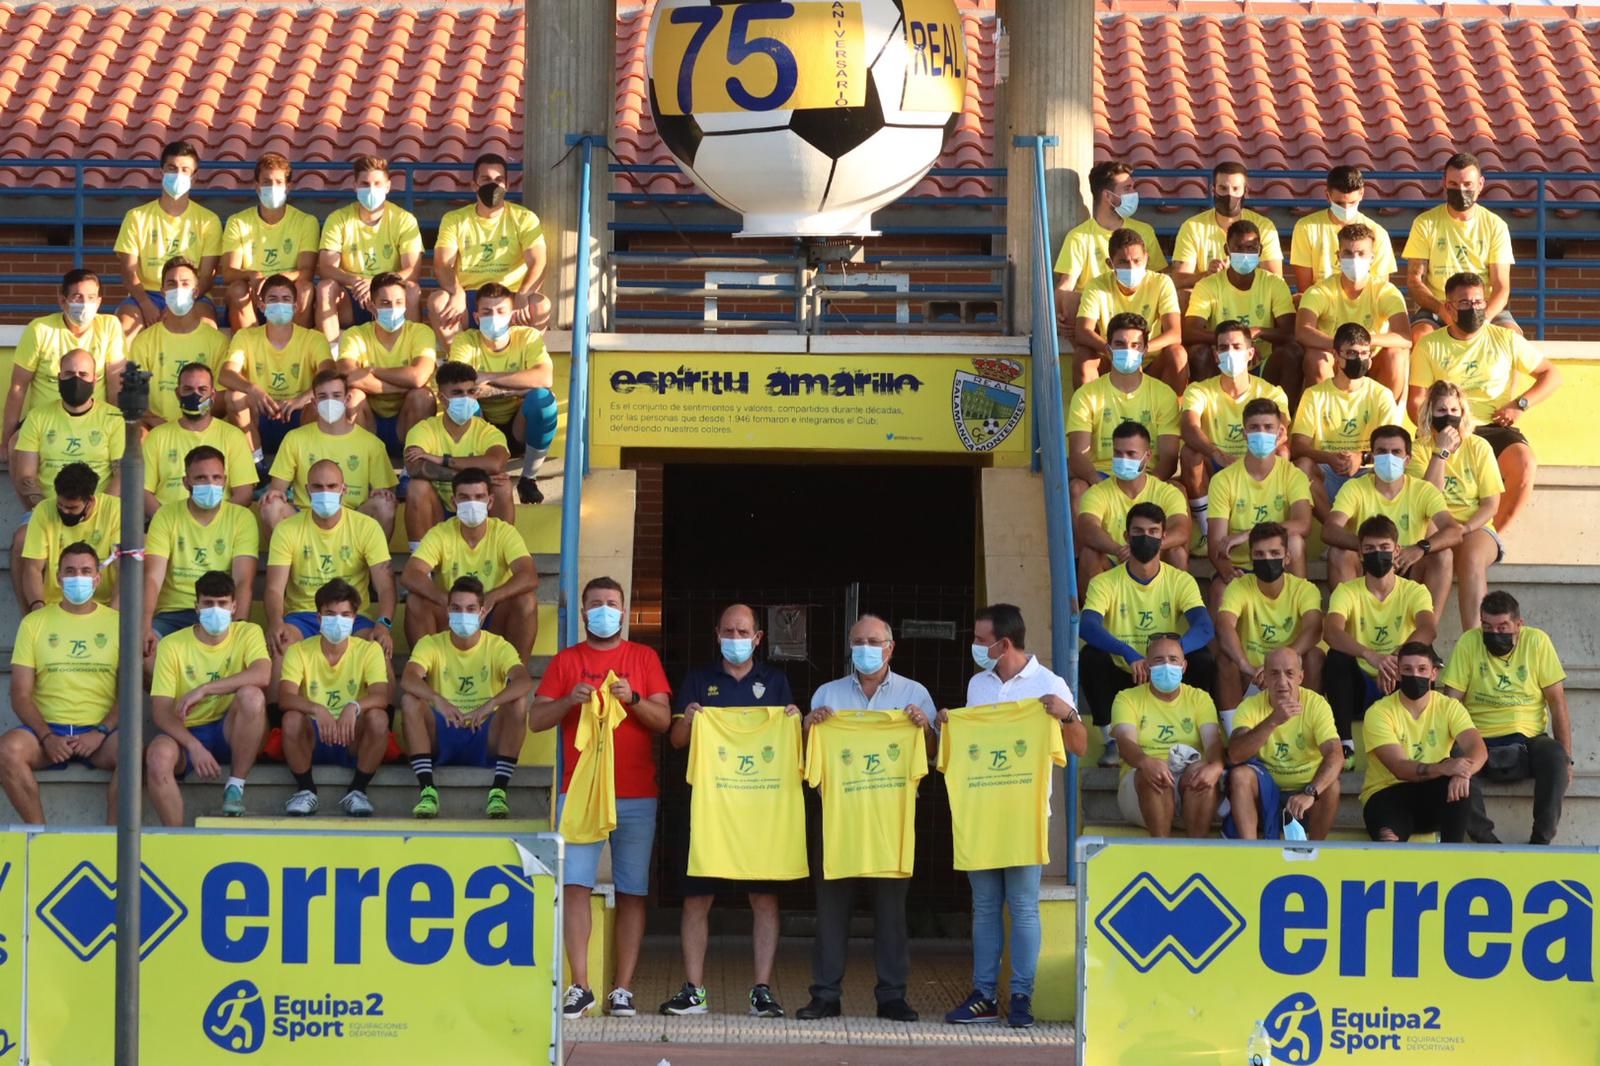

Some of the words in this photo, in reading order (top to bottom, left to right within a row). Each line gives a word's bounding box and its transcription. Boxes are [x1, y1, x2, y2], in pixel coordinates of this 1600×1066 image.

[832, 1, 848, 106] ANIVERSARIO
[910, 21, 961, 78] REAL
[669, 2, 798, 114] 75
[264, 249, 278, 265] 75
[272, 373, 285, 388] 75
[765, 367, 924, 396] amarillo
[974, 376, 1011, 392] REAL
[633, 403, 667, 412] conjunto
[736, 405, 742, 413] y
[778, 404, 829, 414] compartidos
[832, 405, 864, 413] durante
[953, 378, 976, 451] SALAMANCA
[610, 415, 624, 424] por
[626, 413, 638, 421] las
[640, 415, 678, 424] personas
[681, 415, 696, 424] que
[699, 414, 725, 422] desde
[752, 415, 789, 423] formaron
[799, 416, 845, 425] integramos
[975, 397, 1025, 451] MONTERREY
[1342, 418, 1356, 434] 75
[610, 424, 662, 432] defendiendo
[664, 425, 699, 433] nuestros
[1228, 424, 1243, 439] 75
[66, 438, 81, 453] 75
[1444, 476, 1457, 492] 75
[1254, 505, 1268, 521] 75
[194, 548, 207, 563] 75
[320, 555, 332, 570] 75
[1138, 612, 1153, 627] 75
[1261, 624, 1276, 640] 75
[1375, 625, 1388, 641] 75
[70, 640, 87, 656] 75
[459, 676, 474, 692] 75
[1497, 675, 1510, 689] 75
[326, 691, 340, 707] 75
[1158, 725, 1174, 741] 75
[1275, 742, 1289, 758] 75
[737, 756, 754, 773] 75
[863, 754, 880, 772] 75
[990, 750, 1007, 768] 75
[274, 992, 384, 1020] Equipa2
[349, 1022, 408, 1031] EQUIPACIONES
[1332, 1006, 1441, 1033] Equipa2
[272, 1016, 344, 1042] Sport
[349, 1030, 399, 1038] DEPORTIVAS
[1330, 1029, 1401, 1054] Sport
[1406, 1035, 1465, 1044] EQUIPACIONES
[1406, 1043, 1455, 1052] DEPORTIVAS
